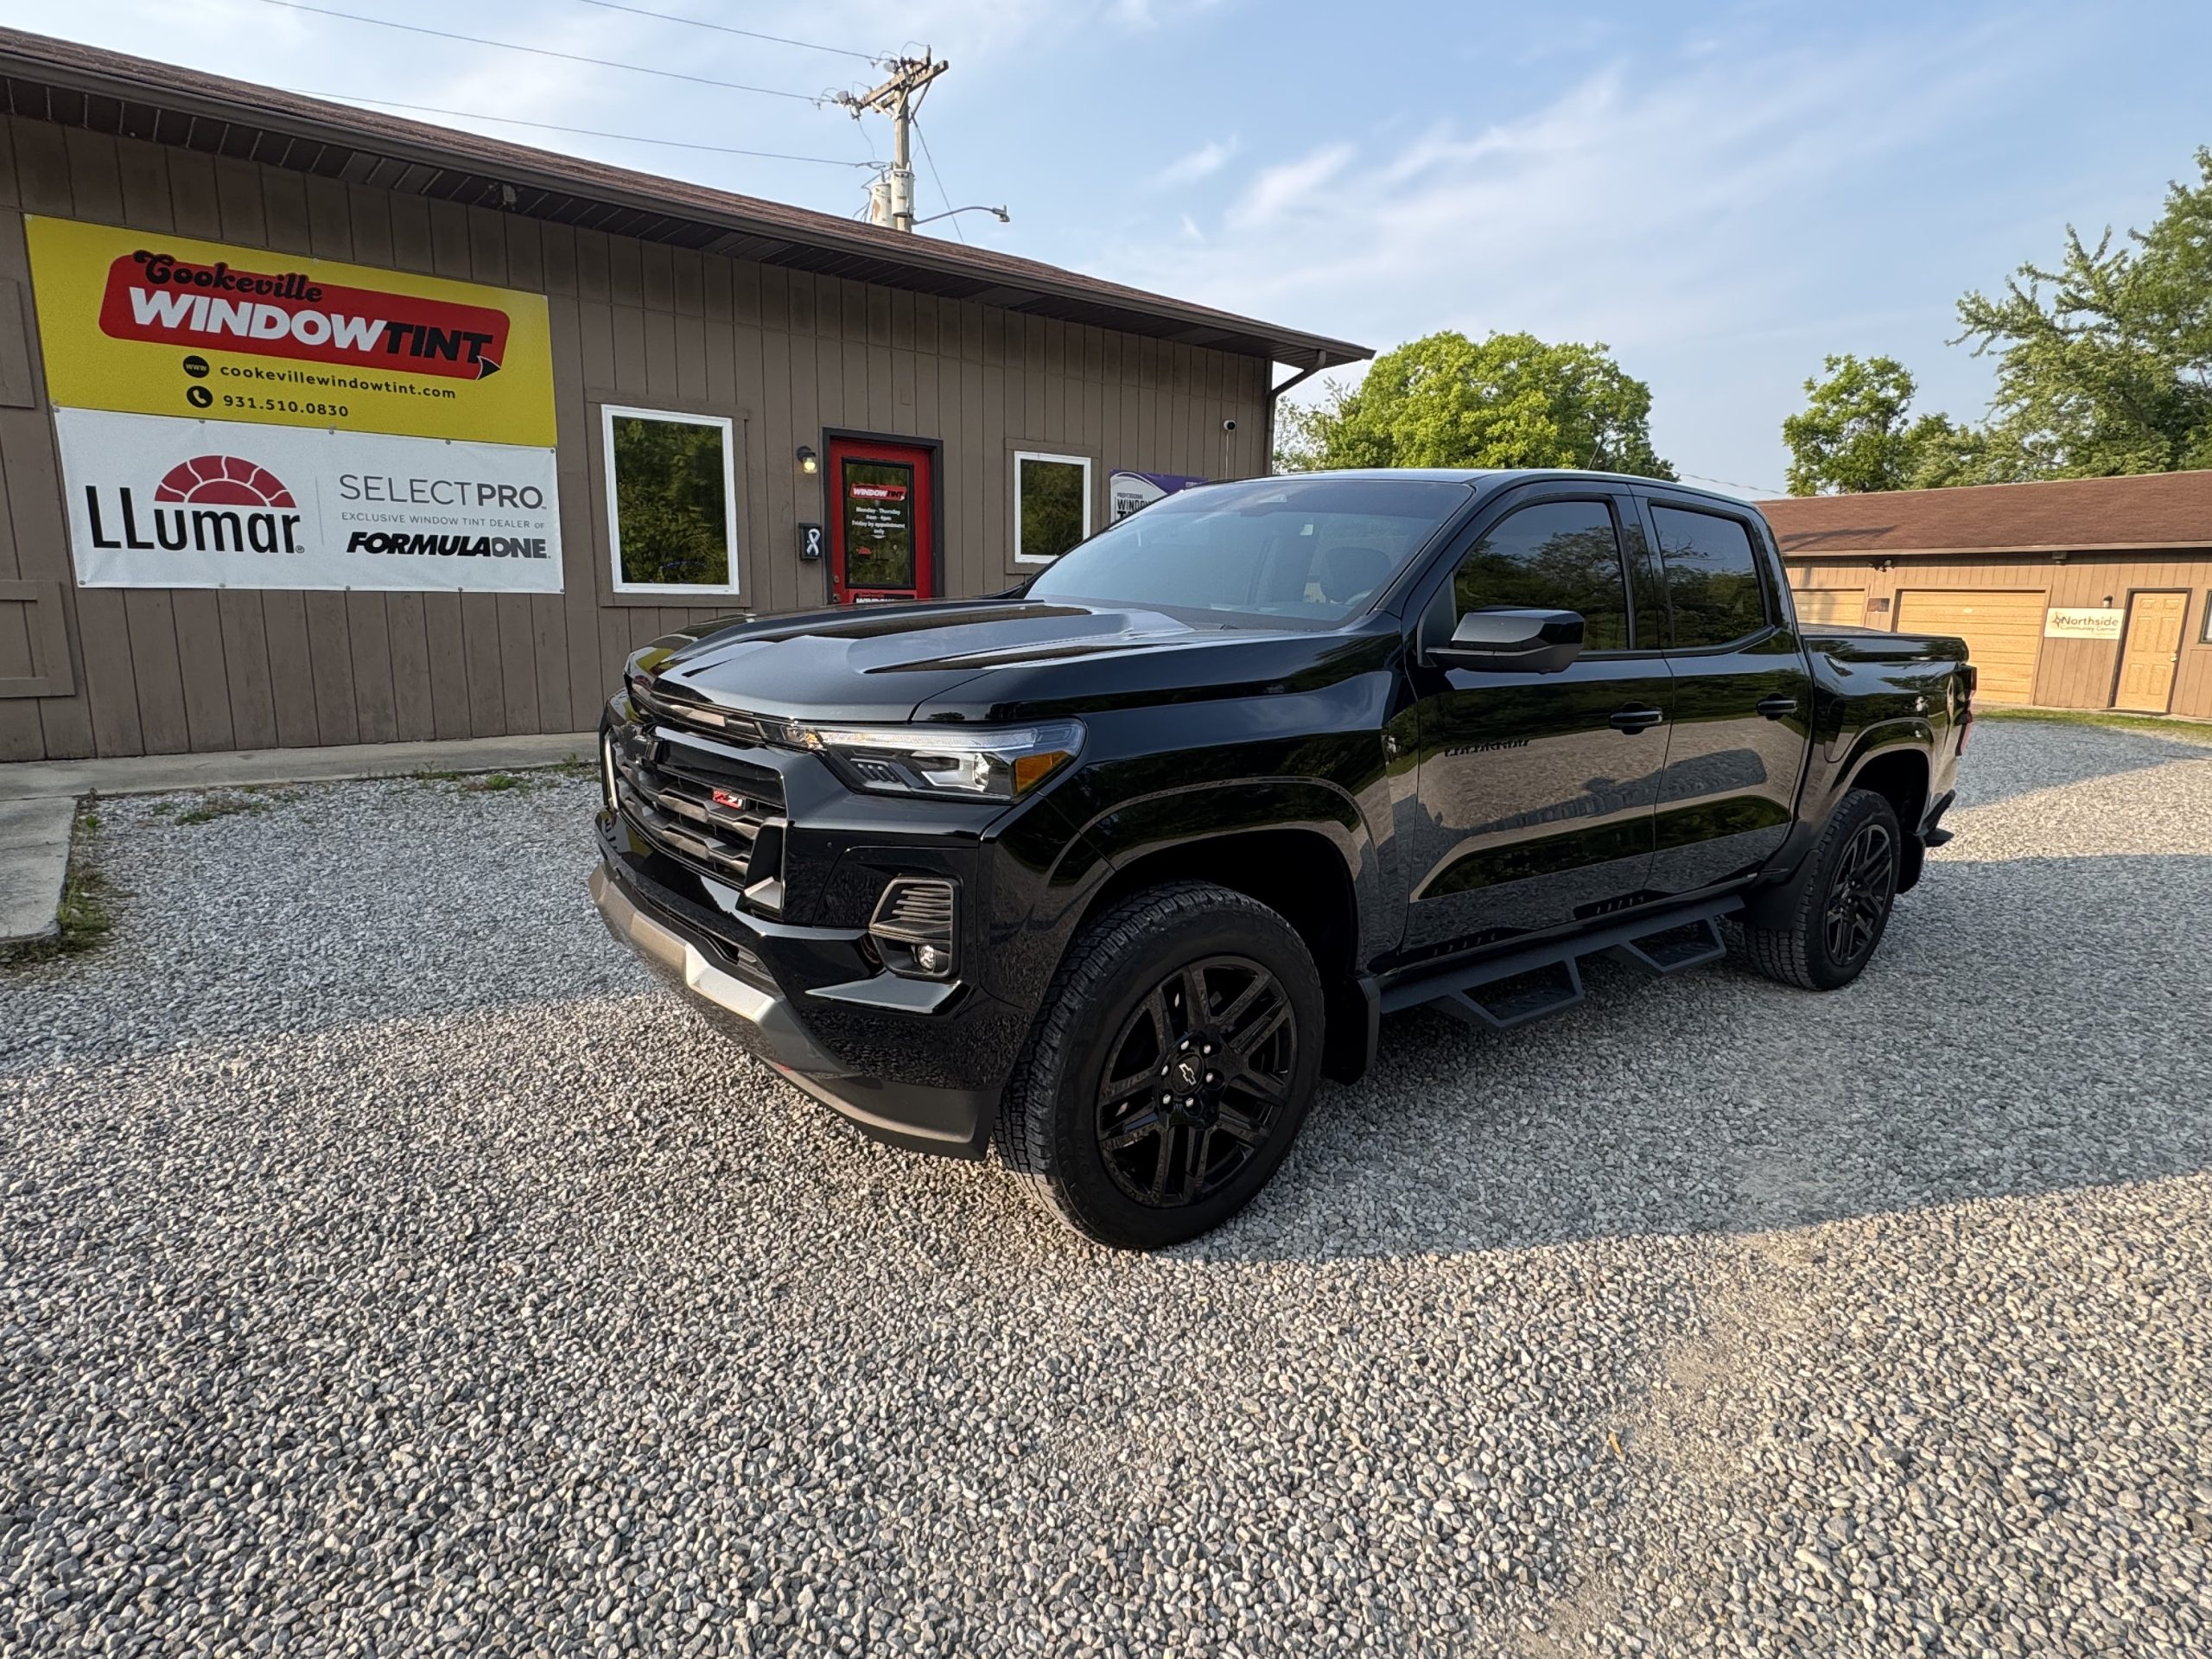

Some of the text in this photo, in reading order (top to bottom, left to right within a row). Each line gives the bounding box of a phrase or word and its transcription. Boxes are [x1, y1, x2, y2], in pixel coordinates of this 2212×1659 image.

[133, 250, 322, 302] Cookeville
[220, 366, 456, 398] cookevillewindowtint.com
[223, 395, 348, 416] 931.510.0830
[341, 512, 406, 524] EXCLUSIVE
[410, 515, 459, 526] WINDOW
[462, 518, 486, 527] TINT
[490, 518, 531, 529] DEALER
[2062, 616, 2119, 626] Northside
